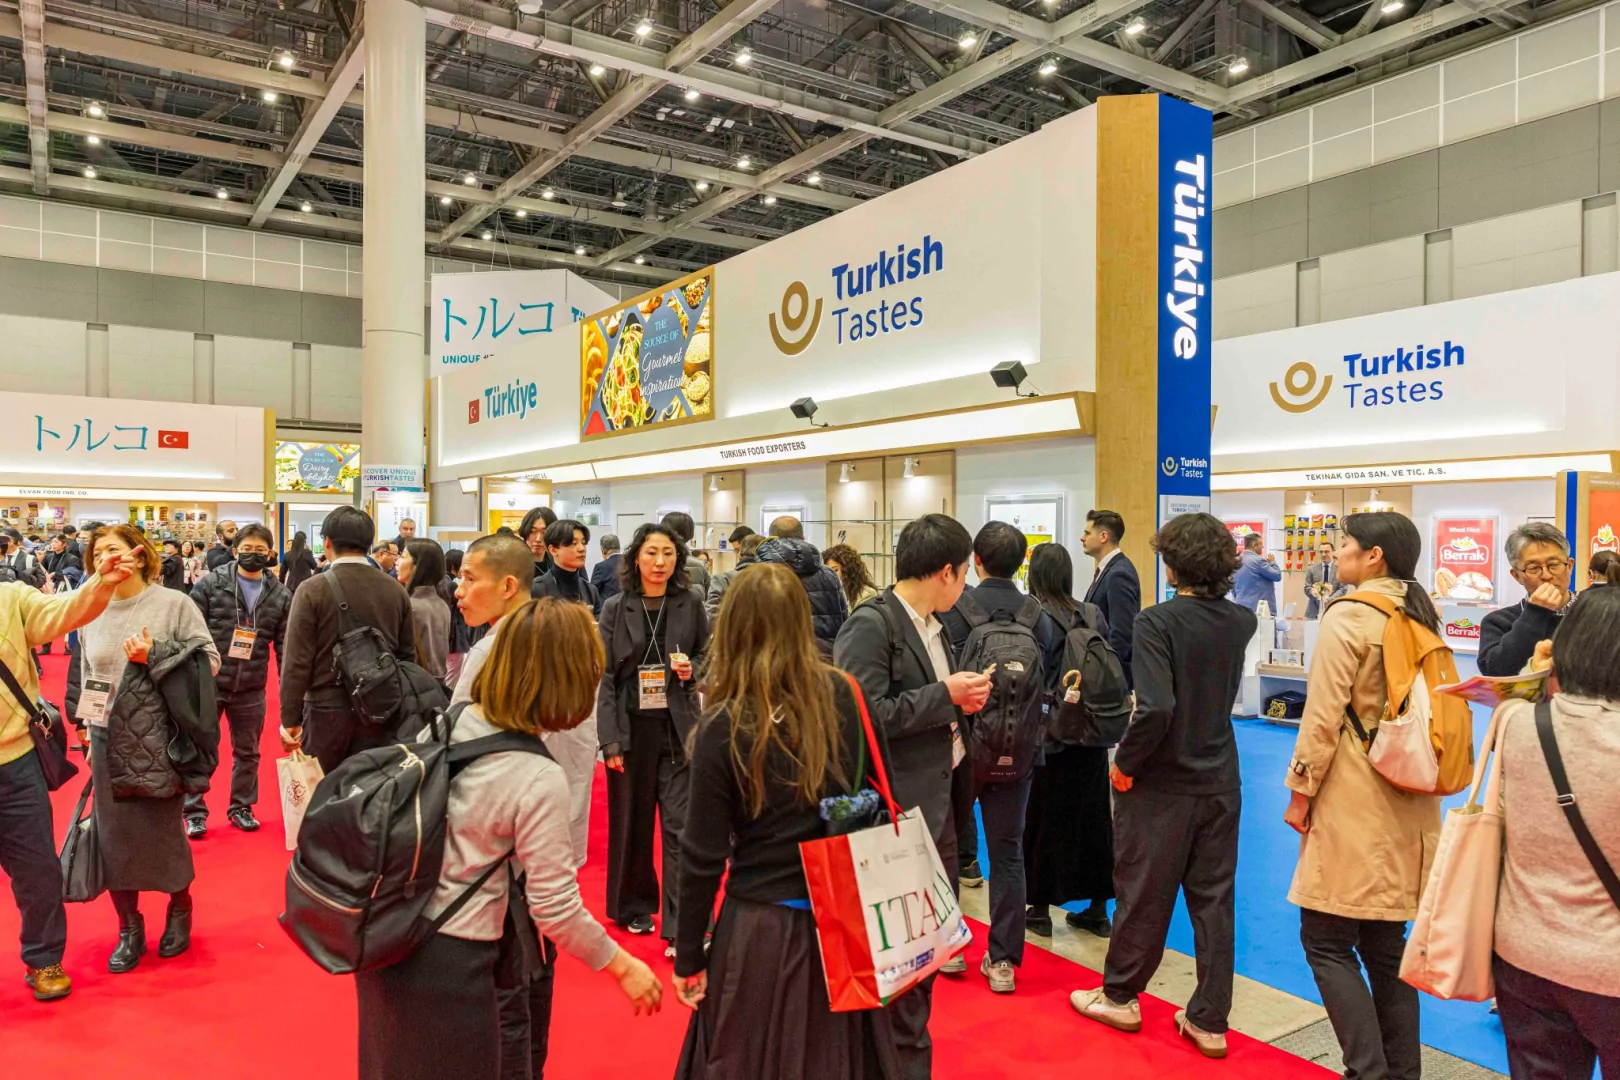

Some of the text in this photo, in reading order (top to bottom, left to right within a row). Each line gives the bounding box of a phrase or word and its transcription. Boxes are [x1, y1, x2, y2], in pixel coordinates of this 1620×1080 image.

[1167, 155, 1205, 360] Türkiye
[832, 235, 943, 300] Turkish
[442, 298, 554, 342] トルコ
[655, 319, 667, 331] THE
[832, 296, 923, 344] Tastes
[644, 330, 679, 349] SOURCE OF
[642, 347, 683, 382] Gourmet
[1343, 340, 1464, 378] Turkish
[485, 378, 537, 420] Türkiye
[1343, 380, 1443, 408] Tastes
[34, 415, 149, 451] トルコ
[720, 441, 806, 459] TURKISH FOOD EXPORTERS
[302, 462, 330, 475] Dairy
[1180, 457, 1207, 468] Turkish
[1180, 468, 1204, 478] Tastes
[1305, 467, 1446, 481] TEKINAK GIDA SAN. VE TIC. A.S.
[581, 495, 601, 506] Armada
[1443, 549, 1485, 561] Berrak
[1447, 626, 1480, 637] Berrak
